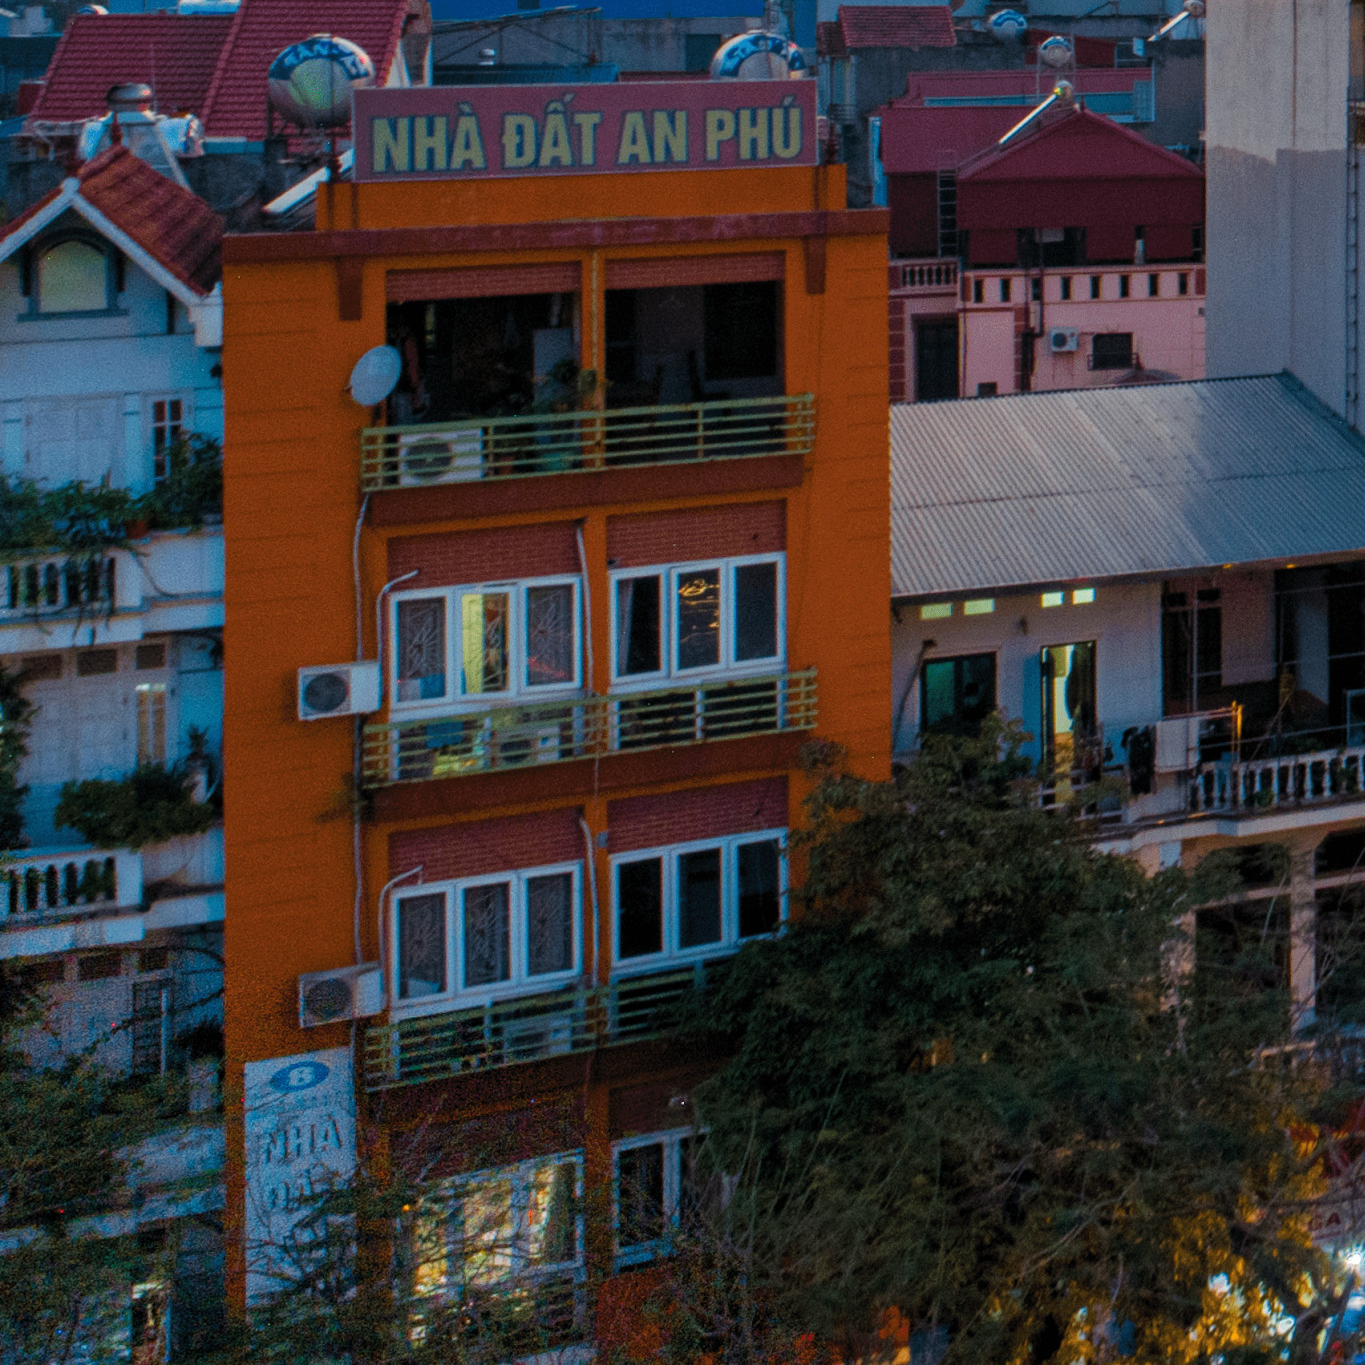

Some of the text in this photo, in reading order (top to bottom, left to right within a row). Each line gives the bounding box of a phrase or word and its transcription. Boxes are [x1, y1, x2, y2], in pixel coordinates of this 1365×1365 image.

[371, 92, 803, 174] NHÀ ĐẤT AN PHÚ
